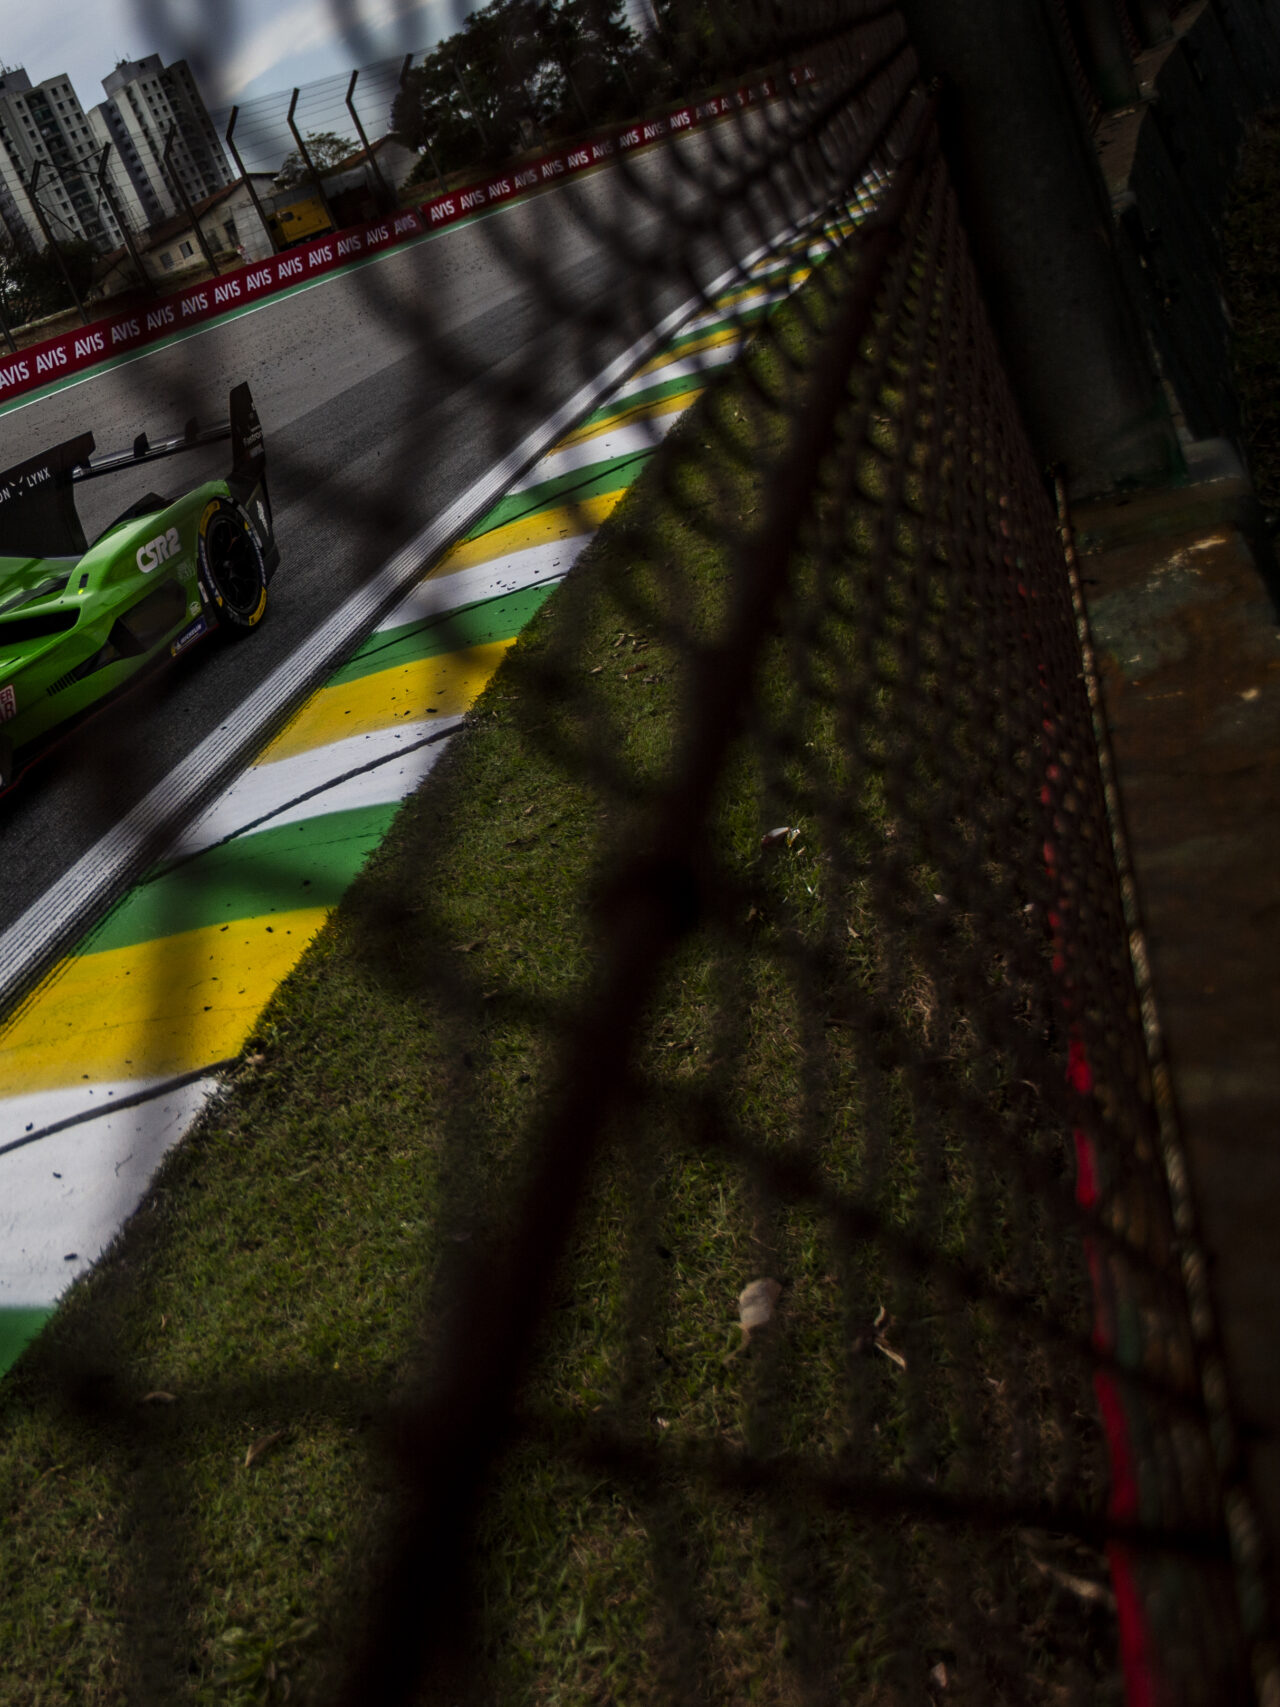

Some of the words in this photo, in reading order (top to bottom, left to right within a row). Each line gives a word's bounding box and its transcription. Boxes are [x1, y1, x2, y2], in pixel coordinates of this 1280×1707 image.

[36, 347, 67, 374] AVIS
[74, 333, 104, 359] AVIS
[111, 319, 140, 344] AVIS
[146, 306, 174, 331] AVIS
[181, 293, 208, 317] AVIS
[214, 281, 241, 304] AVIS
[246, 269, 272, 292] AVIS
[278, 258, 303, 280] AVIS
[308, 246, 332, 268] AVIS
[337, 235, 361, 256] AVIS
[366, 225, 389, 246] AVIS
[430, 201, 455, 222] AVIS
[488, 180, 511, 200] AVIS
[568, 151, 589, 169] AVIS
[619, 129, 640, 149] AVIS
[669, 109, 690, 130] AVIS
[26, 467, 51, 488] LYNX
[136, 527, 182, 573] CSR2
